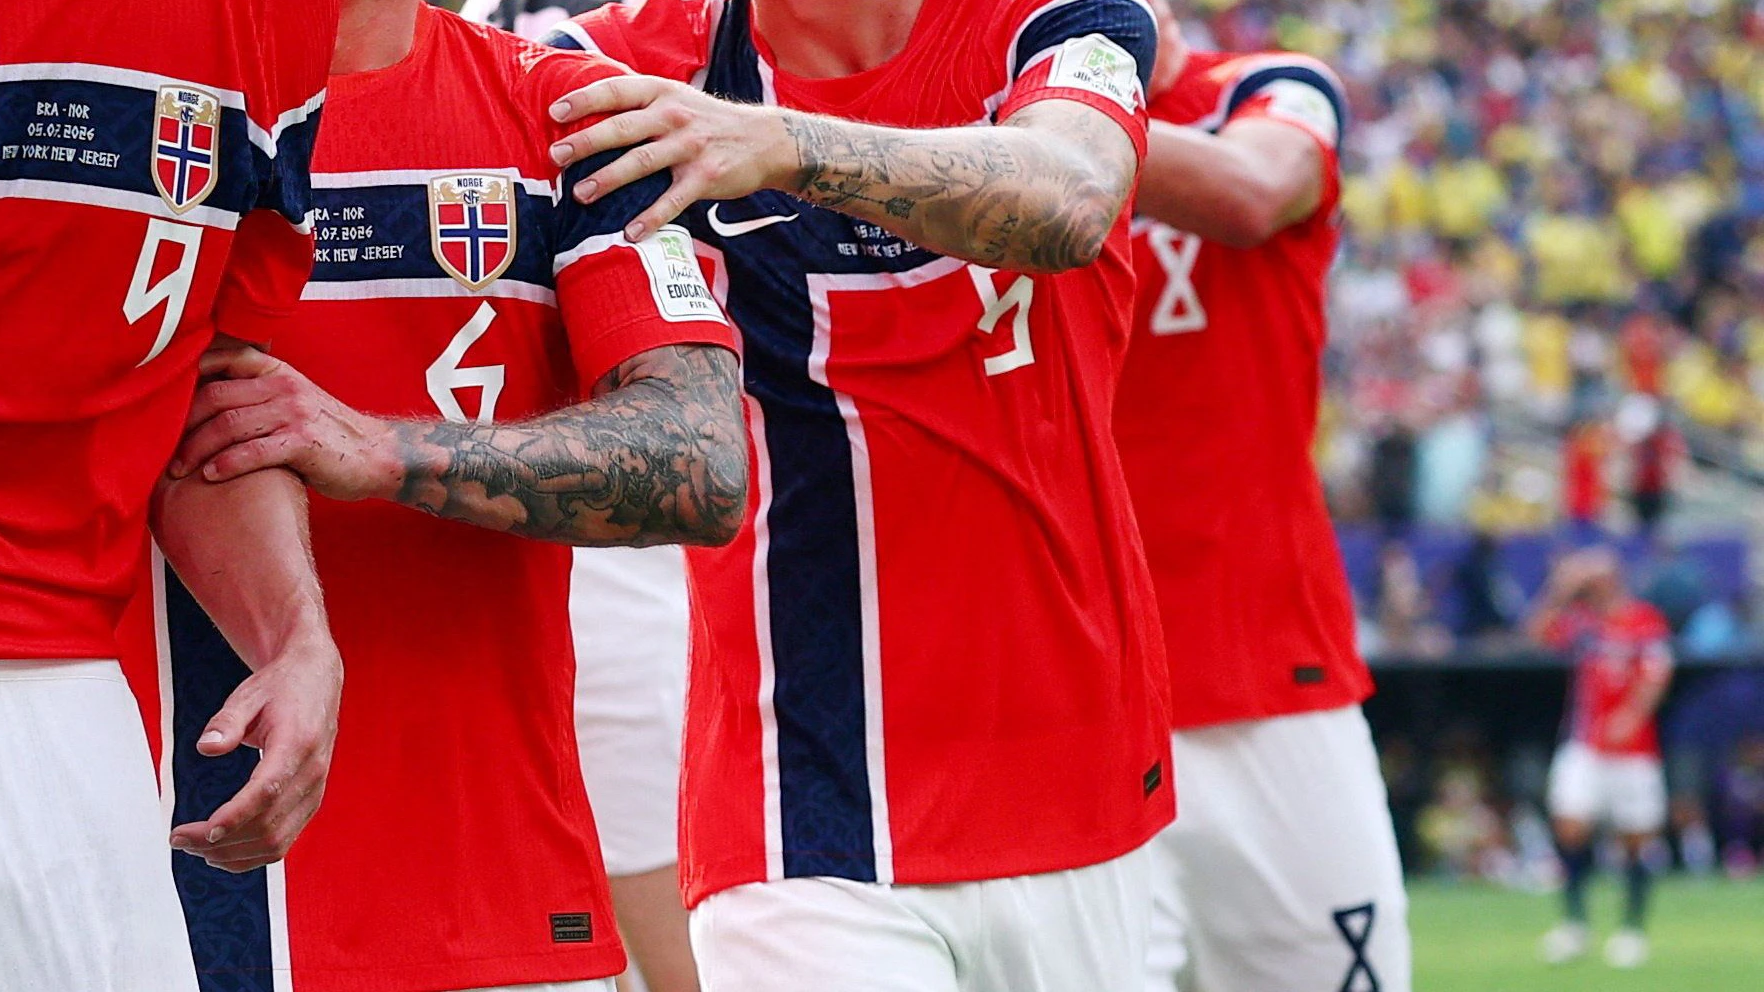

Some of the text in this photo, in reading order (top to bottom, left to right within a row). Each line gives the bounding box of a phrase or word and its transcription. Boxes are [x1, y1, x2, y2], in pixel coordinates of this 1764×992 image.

[36, 101, 59, 116] BRA
[68, 103, 91, 119] NOR
[27, 123, 95, 141] 05.07.2026
[21, 144, 50, 160] YORK
[50, 146, 76, 162] NEW
[78, 149, 120, 168] JERSEY
[457, 177, 483, 188] NORGE
[314, 208, 330, 221] RA
[343, 207, 365, 220] NOR
[315, 245, 405, 262] RK NEW JERSEY
[122, 217, 204, 368] 9
[1147, 225, 1209, 337] 8
[967, 263, 1035, 377] 5
[425, 299, 505, 425] 6
[1332, 902, 1381, 992] 8
